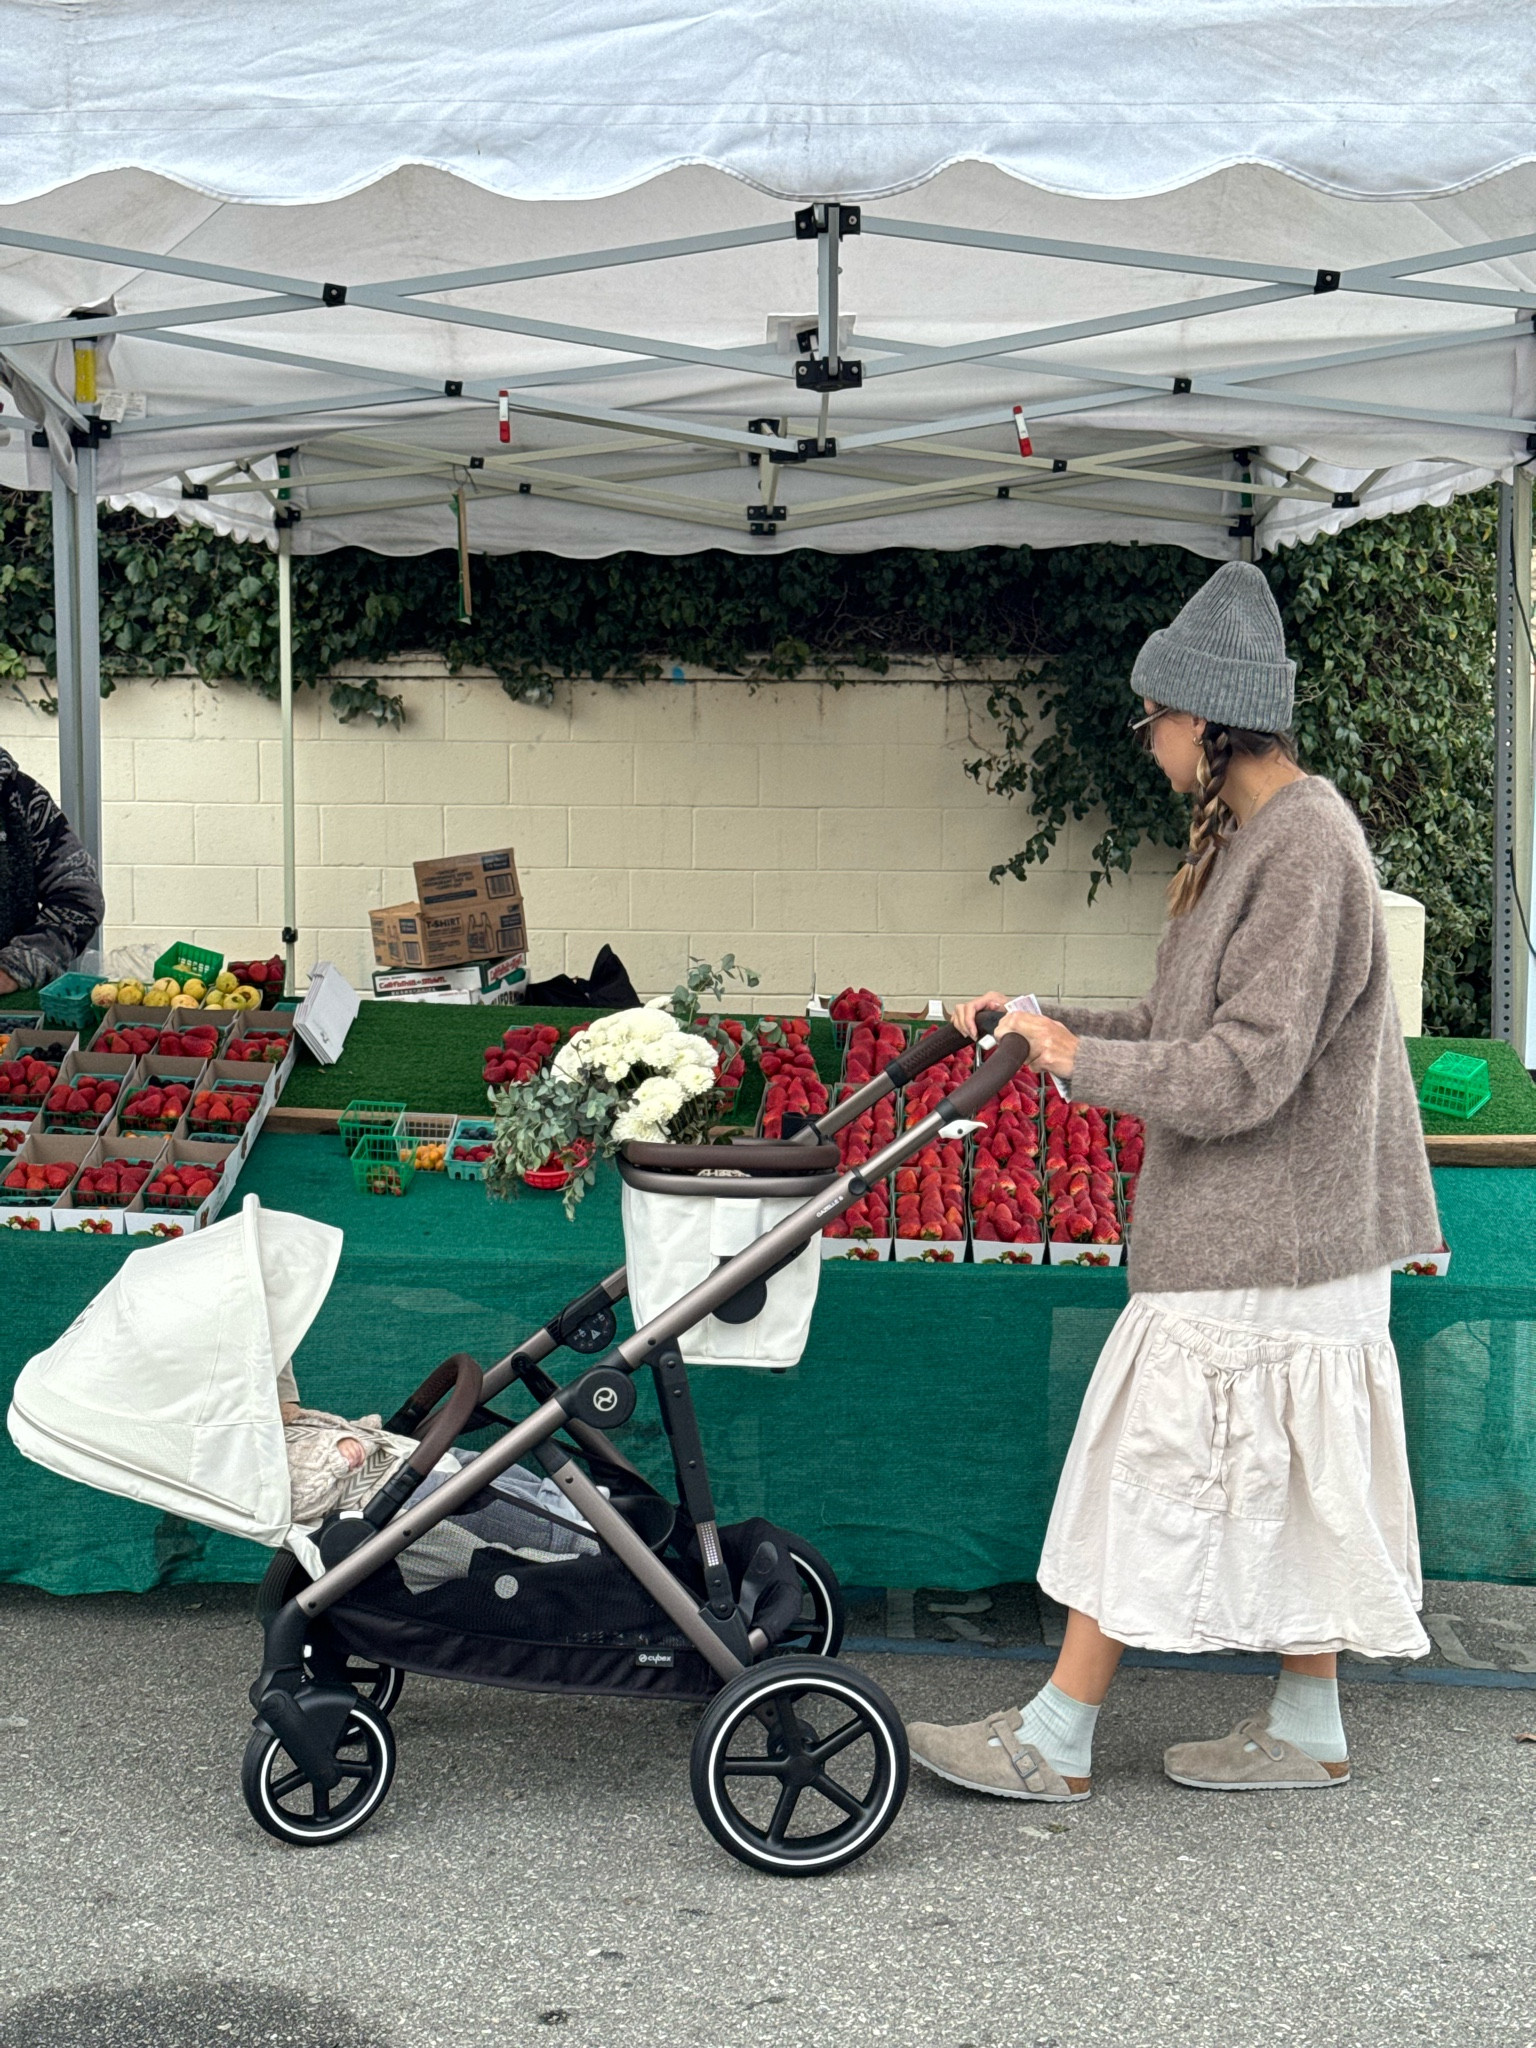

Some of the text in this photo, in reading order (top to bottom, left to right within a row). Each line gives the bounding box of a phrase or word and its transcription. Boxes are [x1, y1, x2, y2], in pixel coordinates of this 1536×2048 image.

[426, 917, 460, 928] T-SHIRT
[816, 1199, 839, 1218] GAZELLE
[647, 1653, 672, 1665] cybex
